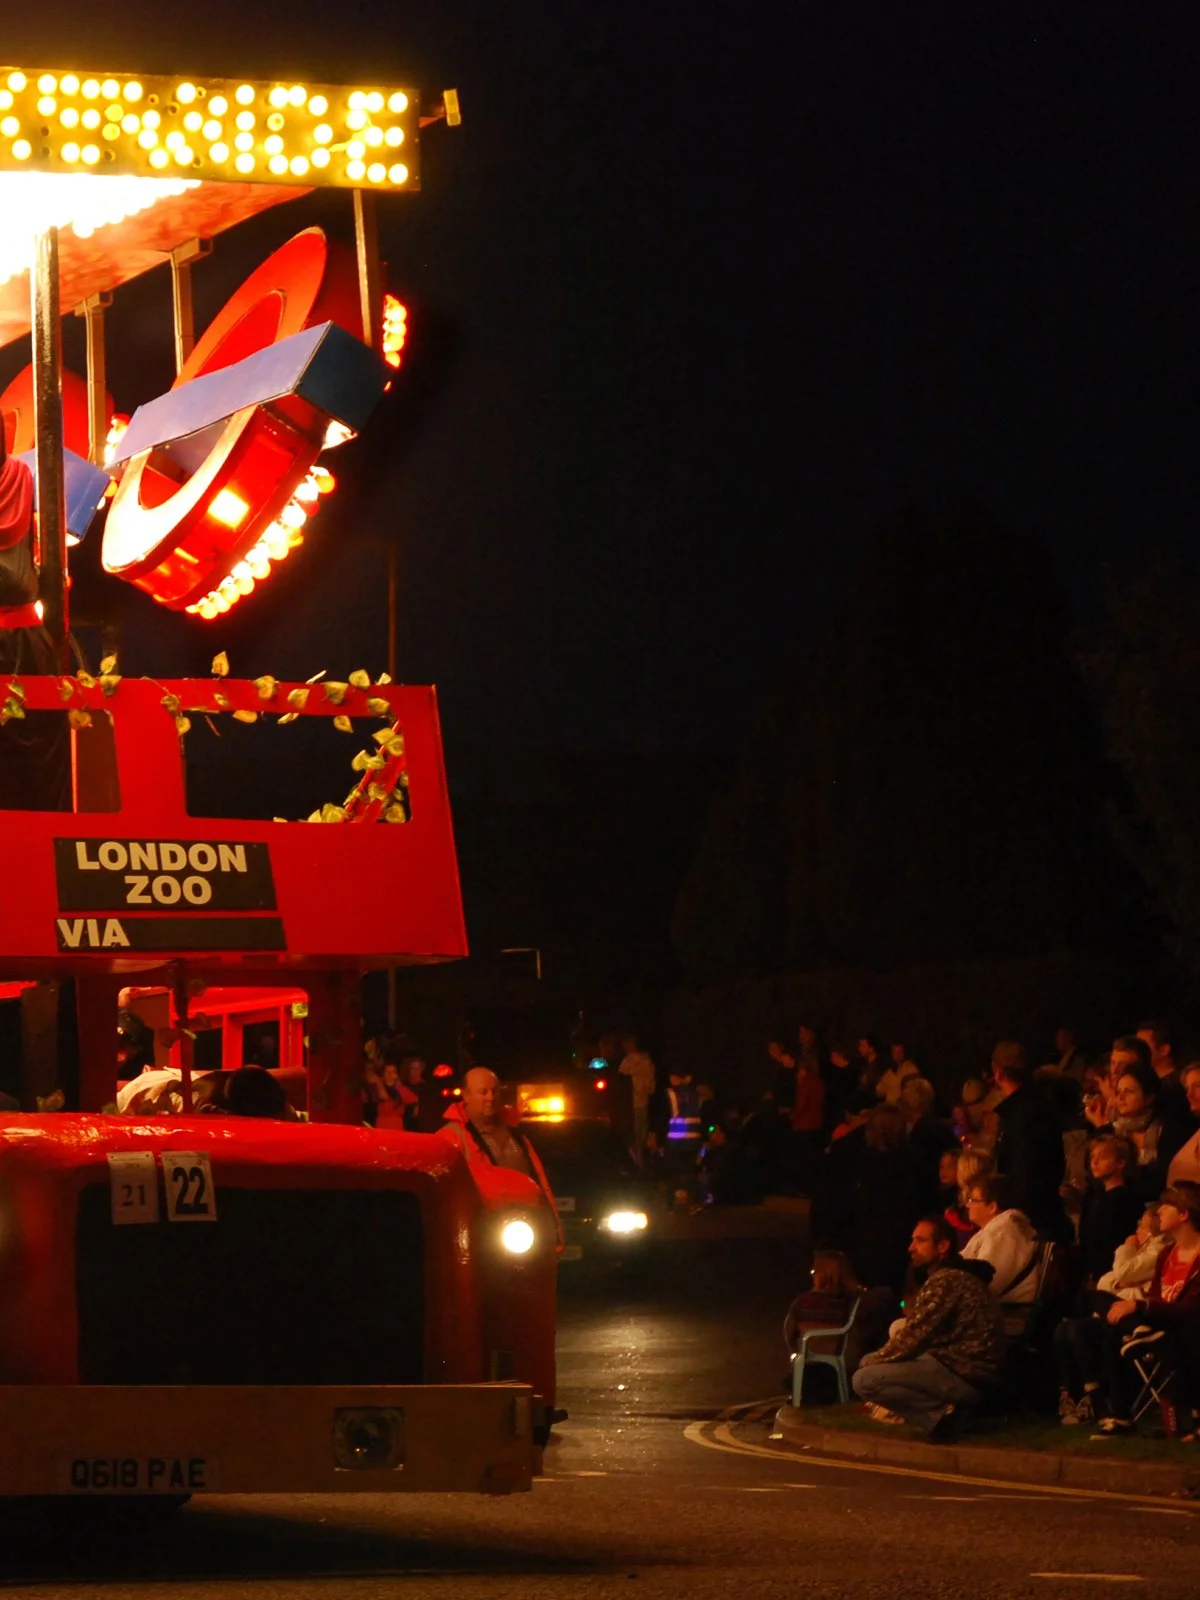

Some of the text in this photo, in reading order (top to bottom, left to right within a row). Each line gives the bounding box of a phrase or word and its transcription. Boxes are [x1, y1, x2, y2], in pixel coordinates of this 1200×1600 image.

[75, 841, 248, 873] LONDON
[124, 875, 212, 905] ZOO
[56, 918, 131, 947] VIA
[121, 1184, 147, 1207] 21
[171, 1166, 209, 1214] 22
[71, 1457, 207, 1488] Q618 PAE
